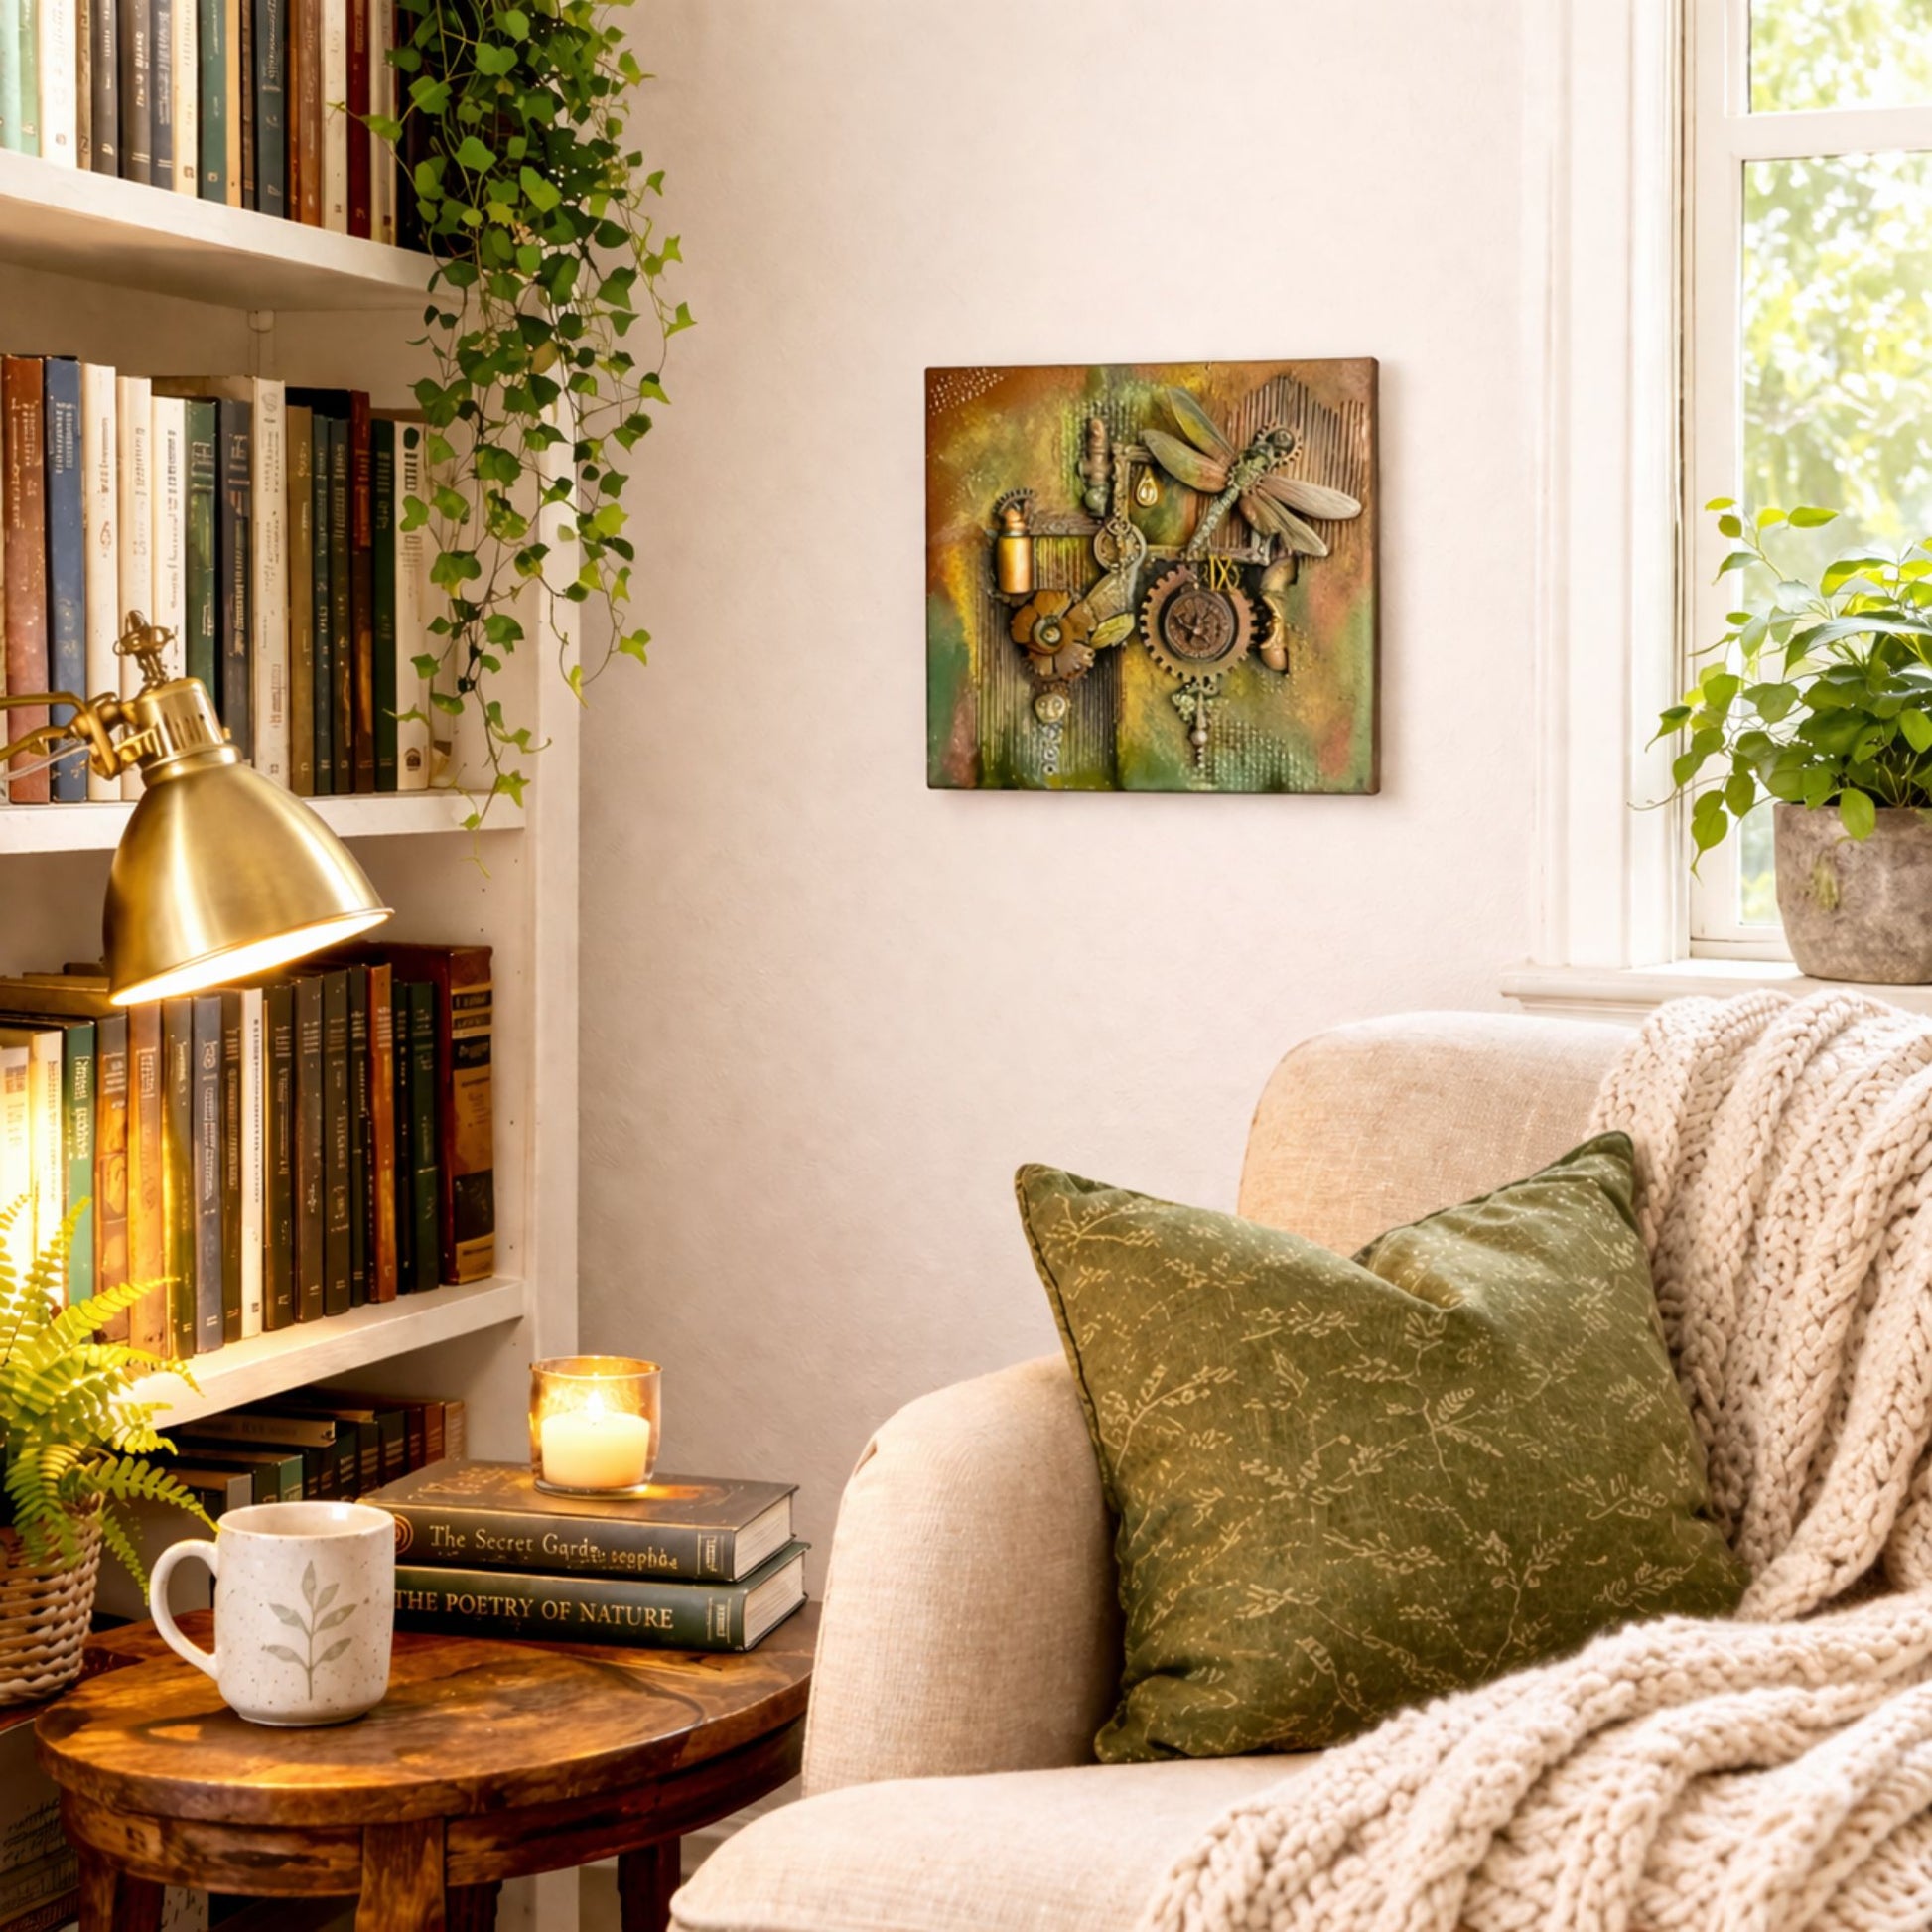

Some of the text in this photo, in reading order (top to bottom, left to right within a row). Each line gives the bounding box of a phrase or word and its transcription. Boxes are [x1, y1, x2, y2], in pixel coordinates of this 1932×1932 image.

[429, 1524, 466, 1548] The
[475, 1528, 534, 1552] Secret
[394, 1589, 674, 1630] THE POETRY OF NATURE
